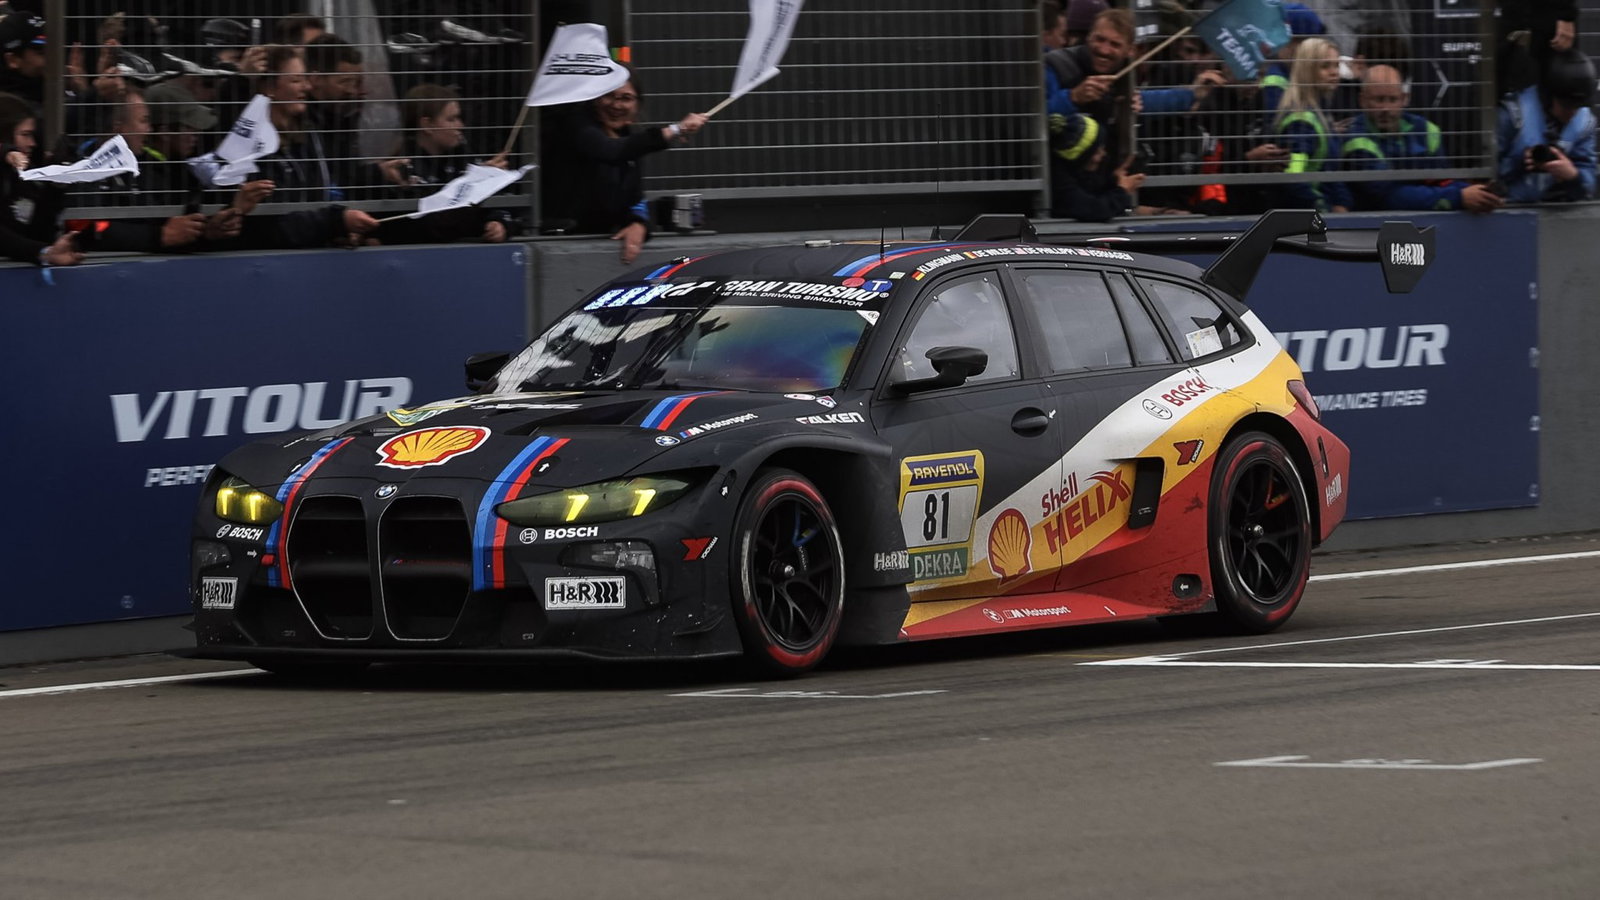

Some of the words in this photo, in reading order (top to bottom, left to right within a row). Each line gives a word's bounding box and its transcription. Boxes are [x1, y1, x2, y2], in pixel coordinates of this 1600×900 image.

[759, 291, 801, 300] DRIVING
[803, 294, 863, 308] SIMULATOR
[778, 281, 880, 301] TURISMO
[1161, 376, 1214, 407] BOSCH
[1381, 388, 1428, 408] TIRES
[110, 377, 412, 442] VITOUR
[795, 412, 865, 425] FALKEN
[913, 462, 974, 480] RAVENOL
[1041, 471, 1079, 518] Shell
[923, 491, 950, 541] 81
[1042, 469, 1132, 555] HELIX
[228, 526, 264, 541] BOSCH
[544, 526, 599, 540] BOSCH
[914, 551, 963, 579] DEKRA
[549, 582, 594, 605] H&R
